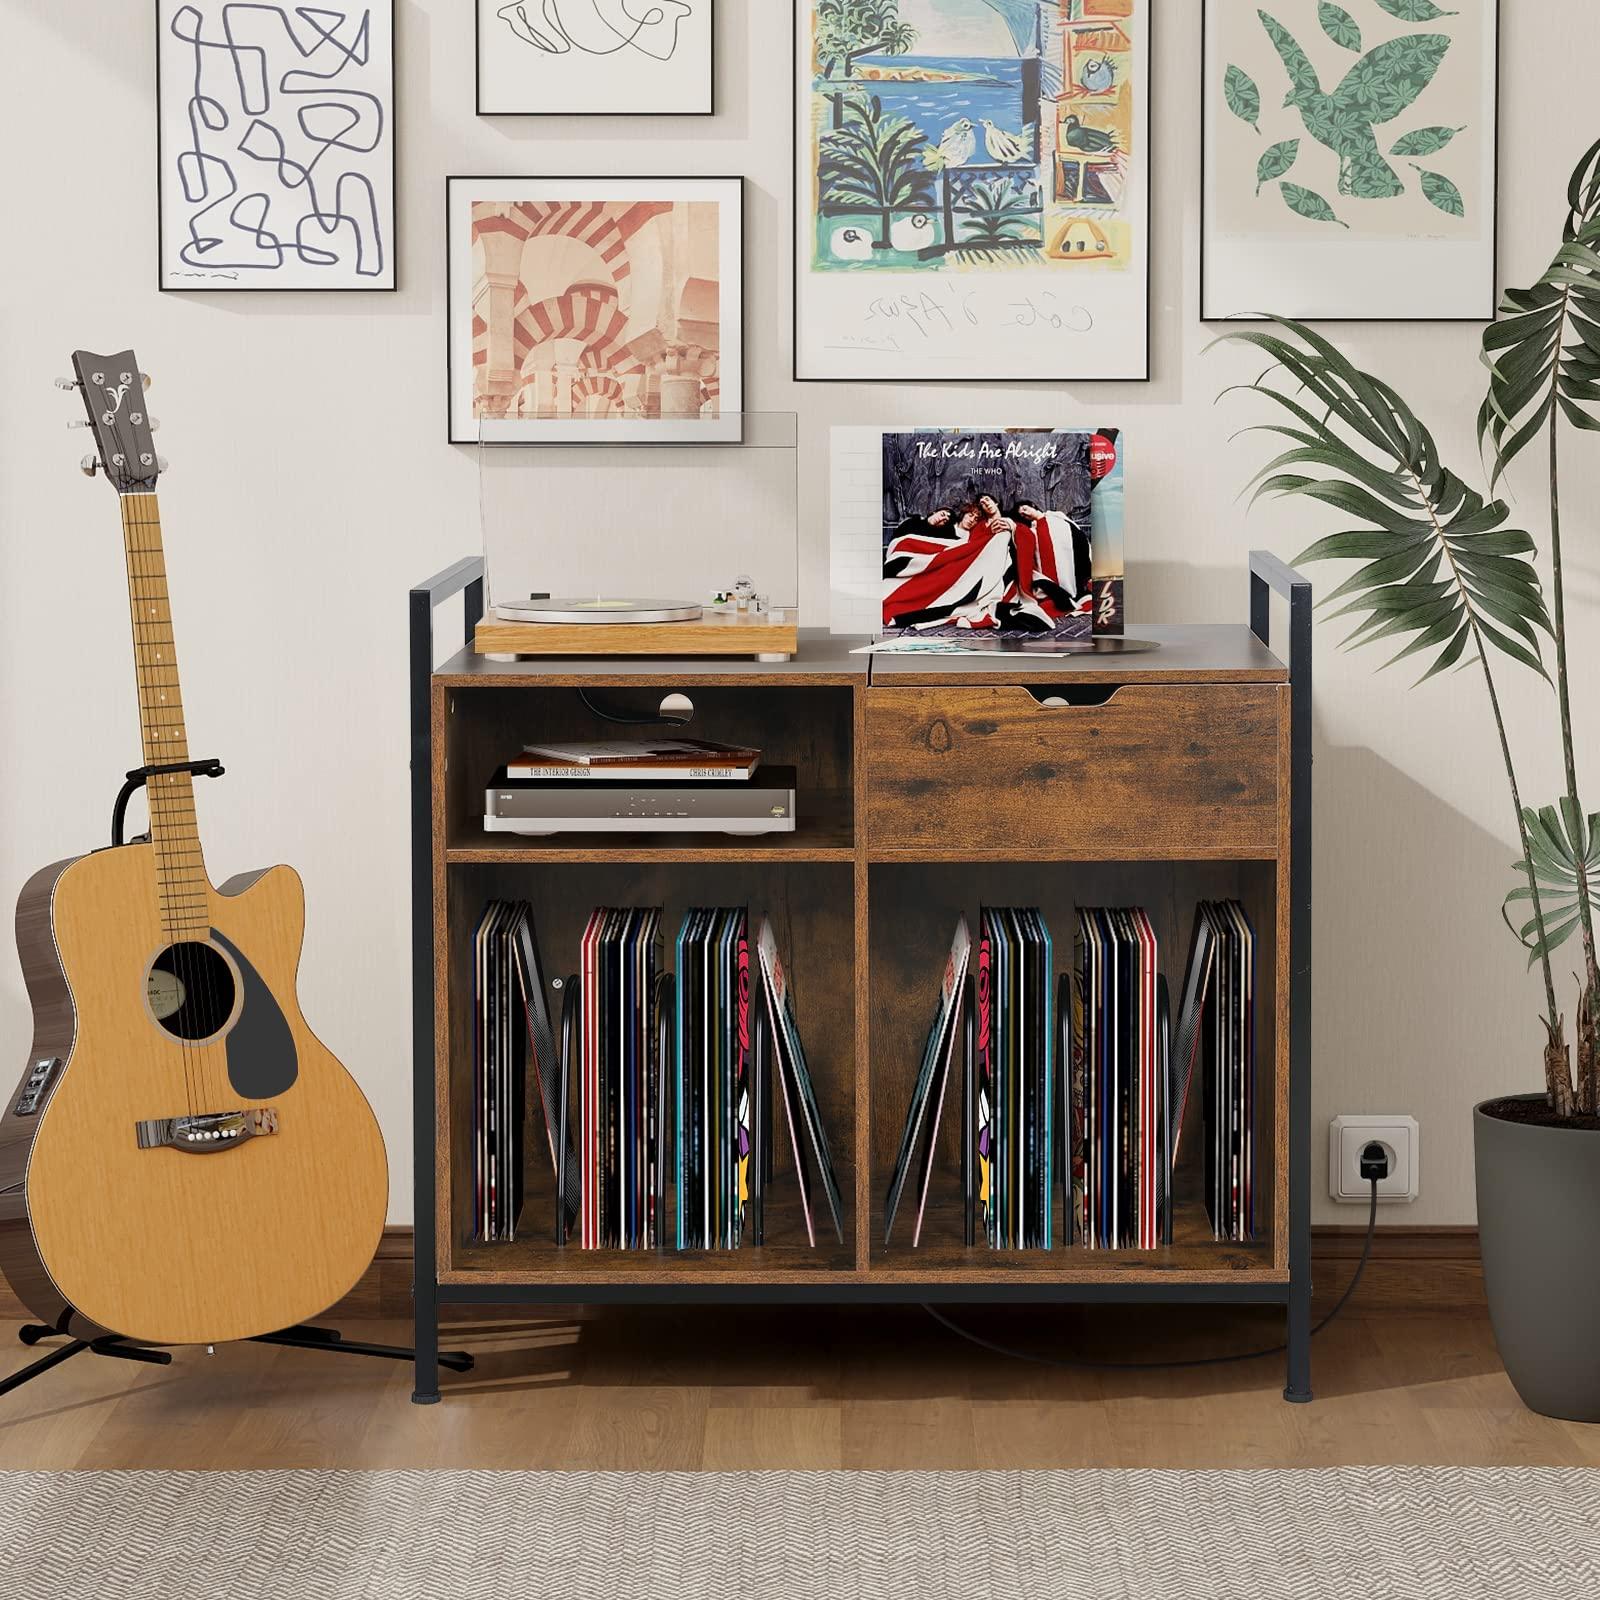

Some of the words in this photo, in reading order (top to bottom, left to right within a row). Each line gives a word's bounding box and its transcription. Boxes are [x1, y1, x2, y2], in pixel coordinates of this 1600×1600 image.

[916, 441, 938, 459] The
[941, 441, 976, 459] Kids
[978, 441, 1003, 460] Are
[1004, 441, 1058, 465] Alright
[971, 467, 983, 476] THE
[984, 467, 1003, 476] WHO
